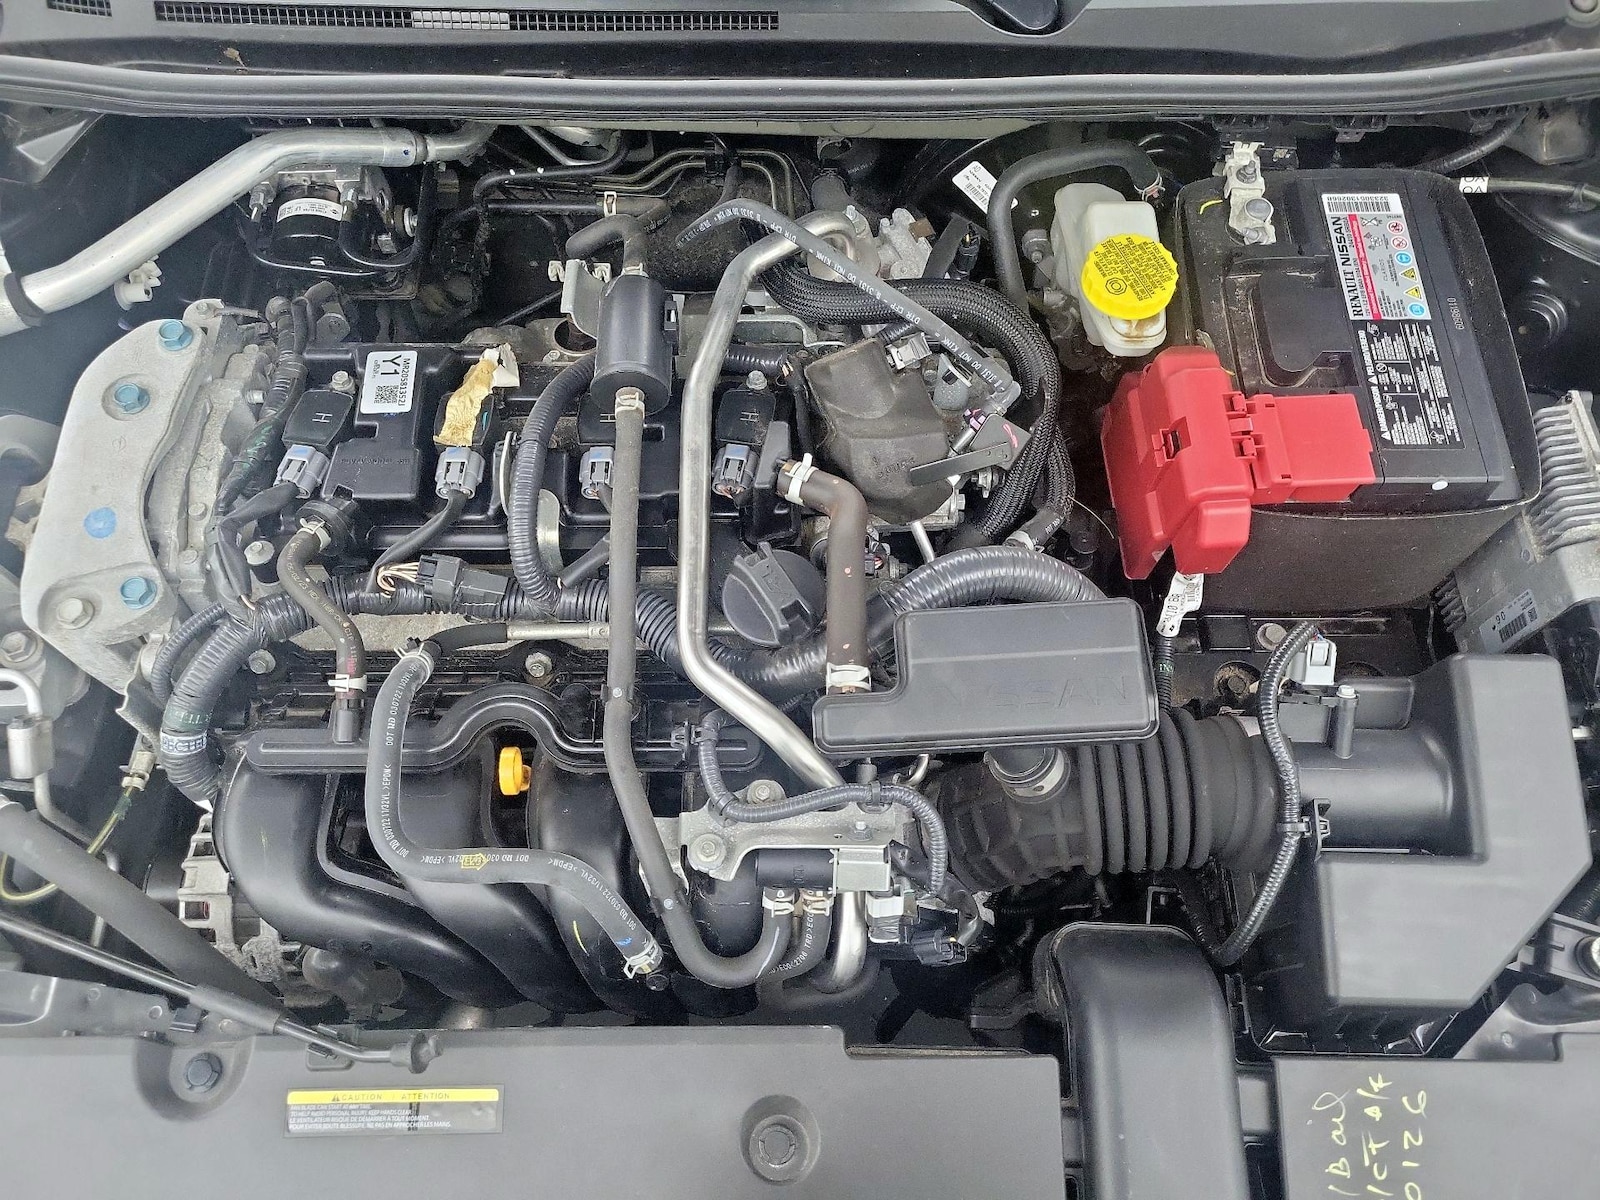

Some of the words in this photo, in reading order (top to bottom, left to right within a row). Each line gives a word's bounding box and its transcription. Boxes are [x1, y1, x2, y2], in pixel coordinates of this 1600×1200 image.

[782, 229, 798, 243] DTR
[1330, 215, 1351, 267] NISSAN
[813, 249, 832, 266] KINK
[857, 278, 875, 294] 3131
[1342, 269, 1363, 317] RENAULT
[904, 310, 921, 325] DTR
[940, 335, 959, 353] KINK
[957, 349, 972, 363] NOT
[381, 353, 402, 376] Y1
[388, 689, 403, 714] 030722
[385, 731, 393, 745] DOT
[341, 1093, 382, 1101] CAUTION
[401, 1092, 450, 1100] ATTENTION
